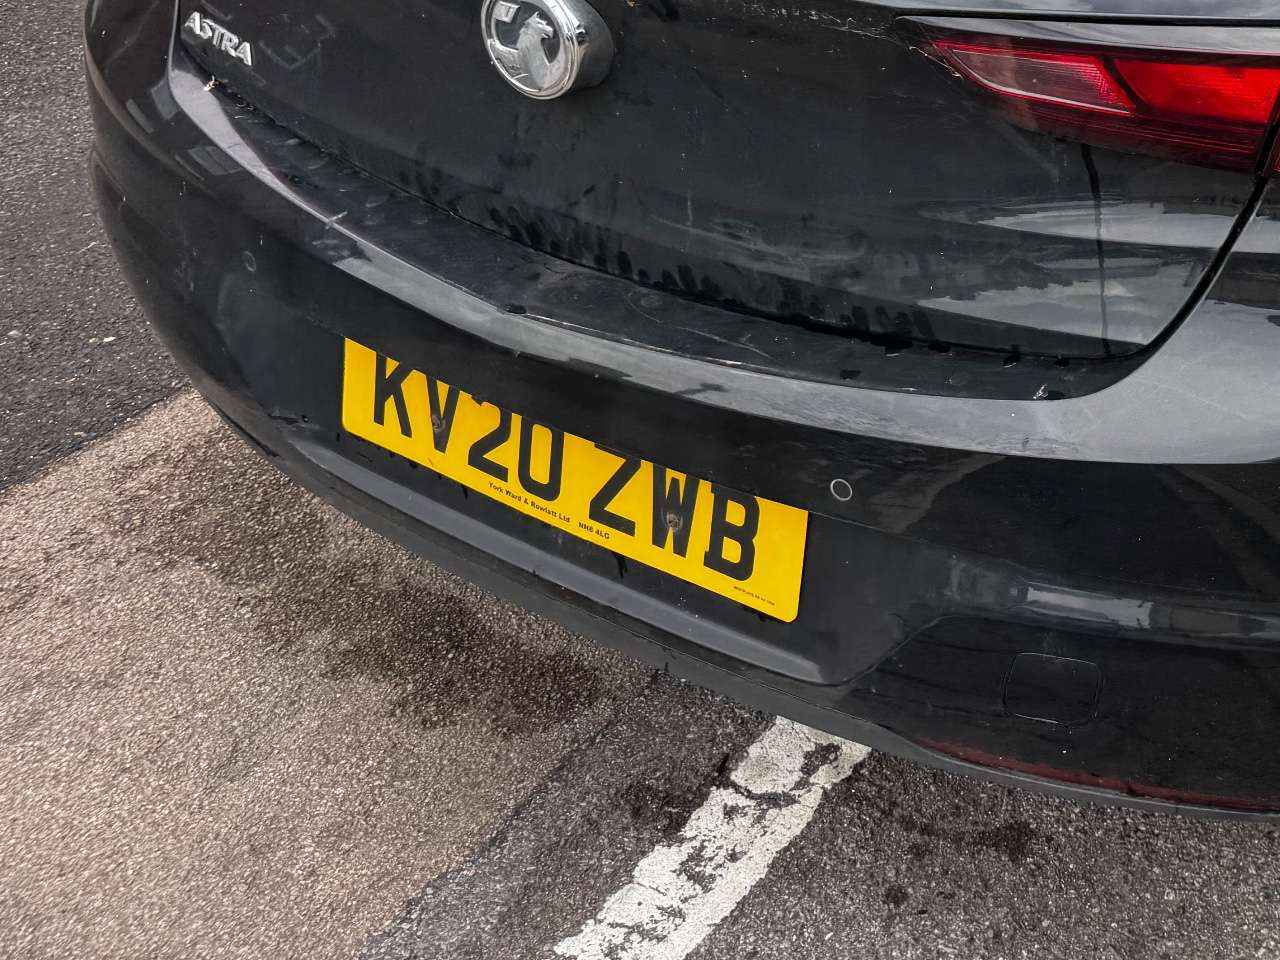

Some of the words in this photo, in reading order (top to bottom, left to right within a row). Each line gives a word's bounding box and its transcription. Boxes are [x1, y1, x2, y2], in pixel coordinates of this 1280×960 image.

[184, 11, 252, 66] ASTRA
[373, 352, 565, 502] KV20
[589, 442, 760, 581] ZWB
[489, 481, 504, 494] York
[505, 488, 522, 502] Ward
[531, 501, 557, 517] Rowlatt
[558, 512, 571, 523] Ltd
[578, 522, 593, 533] NN6
[595, 530, 610, 540] 4LG
